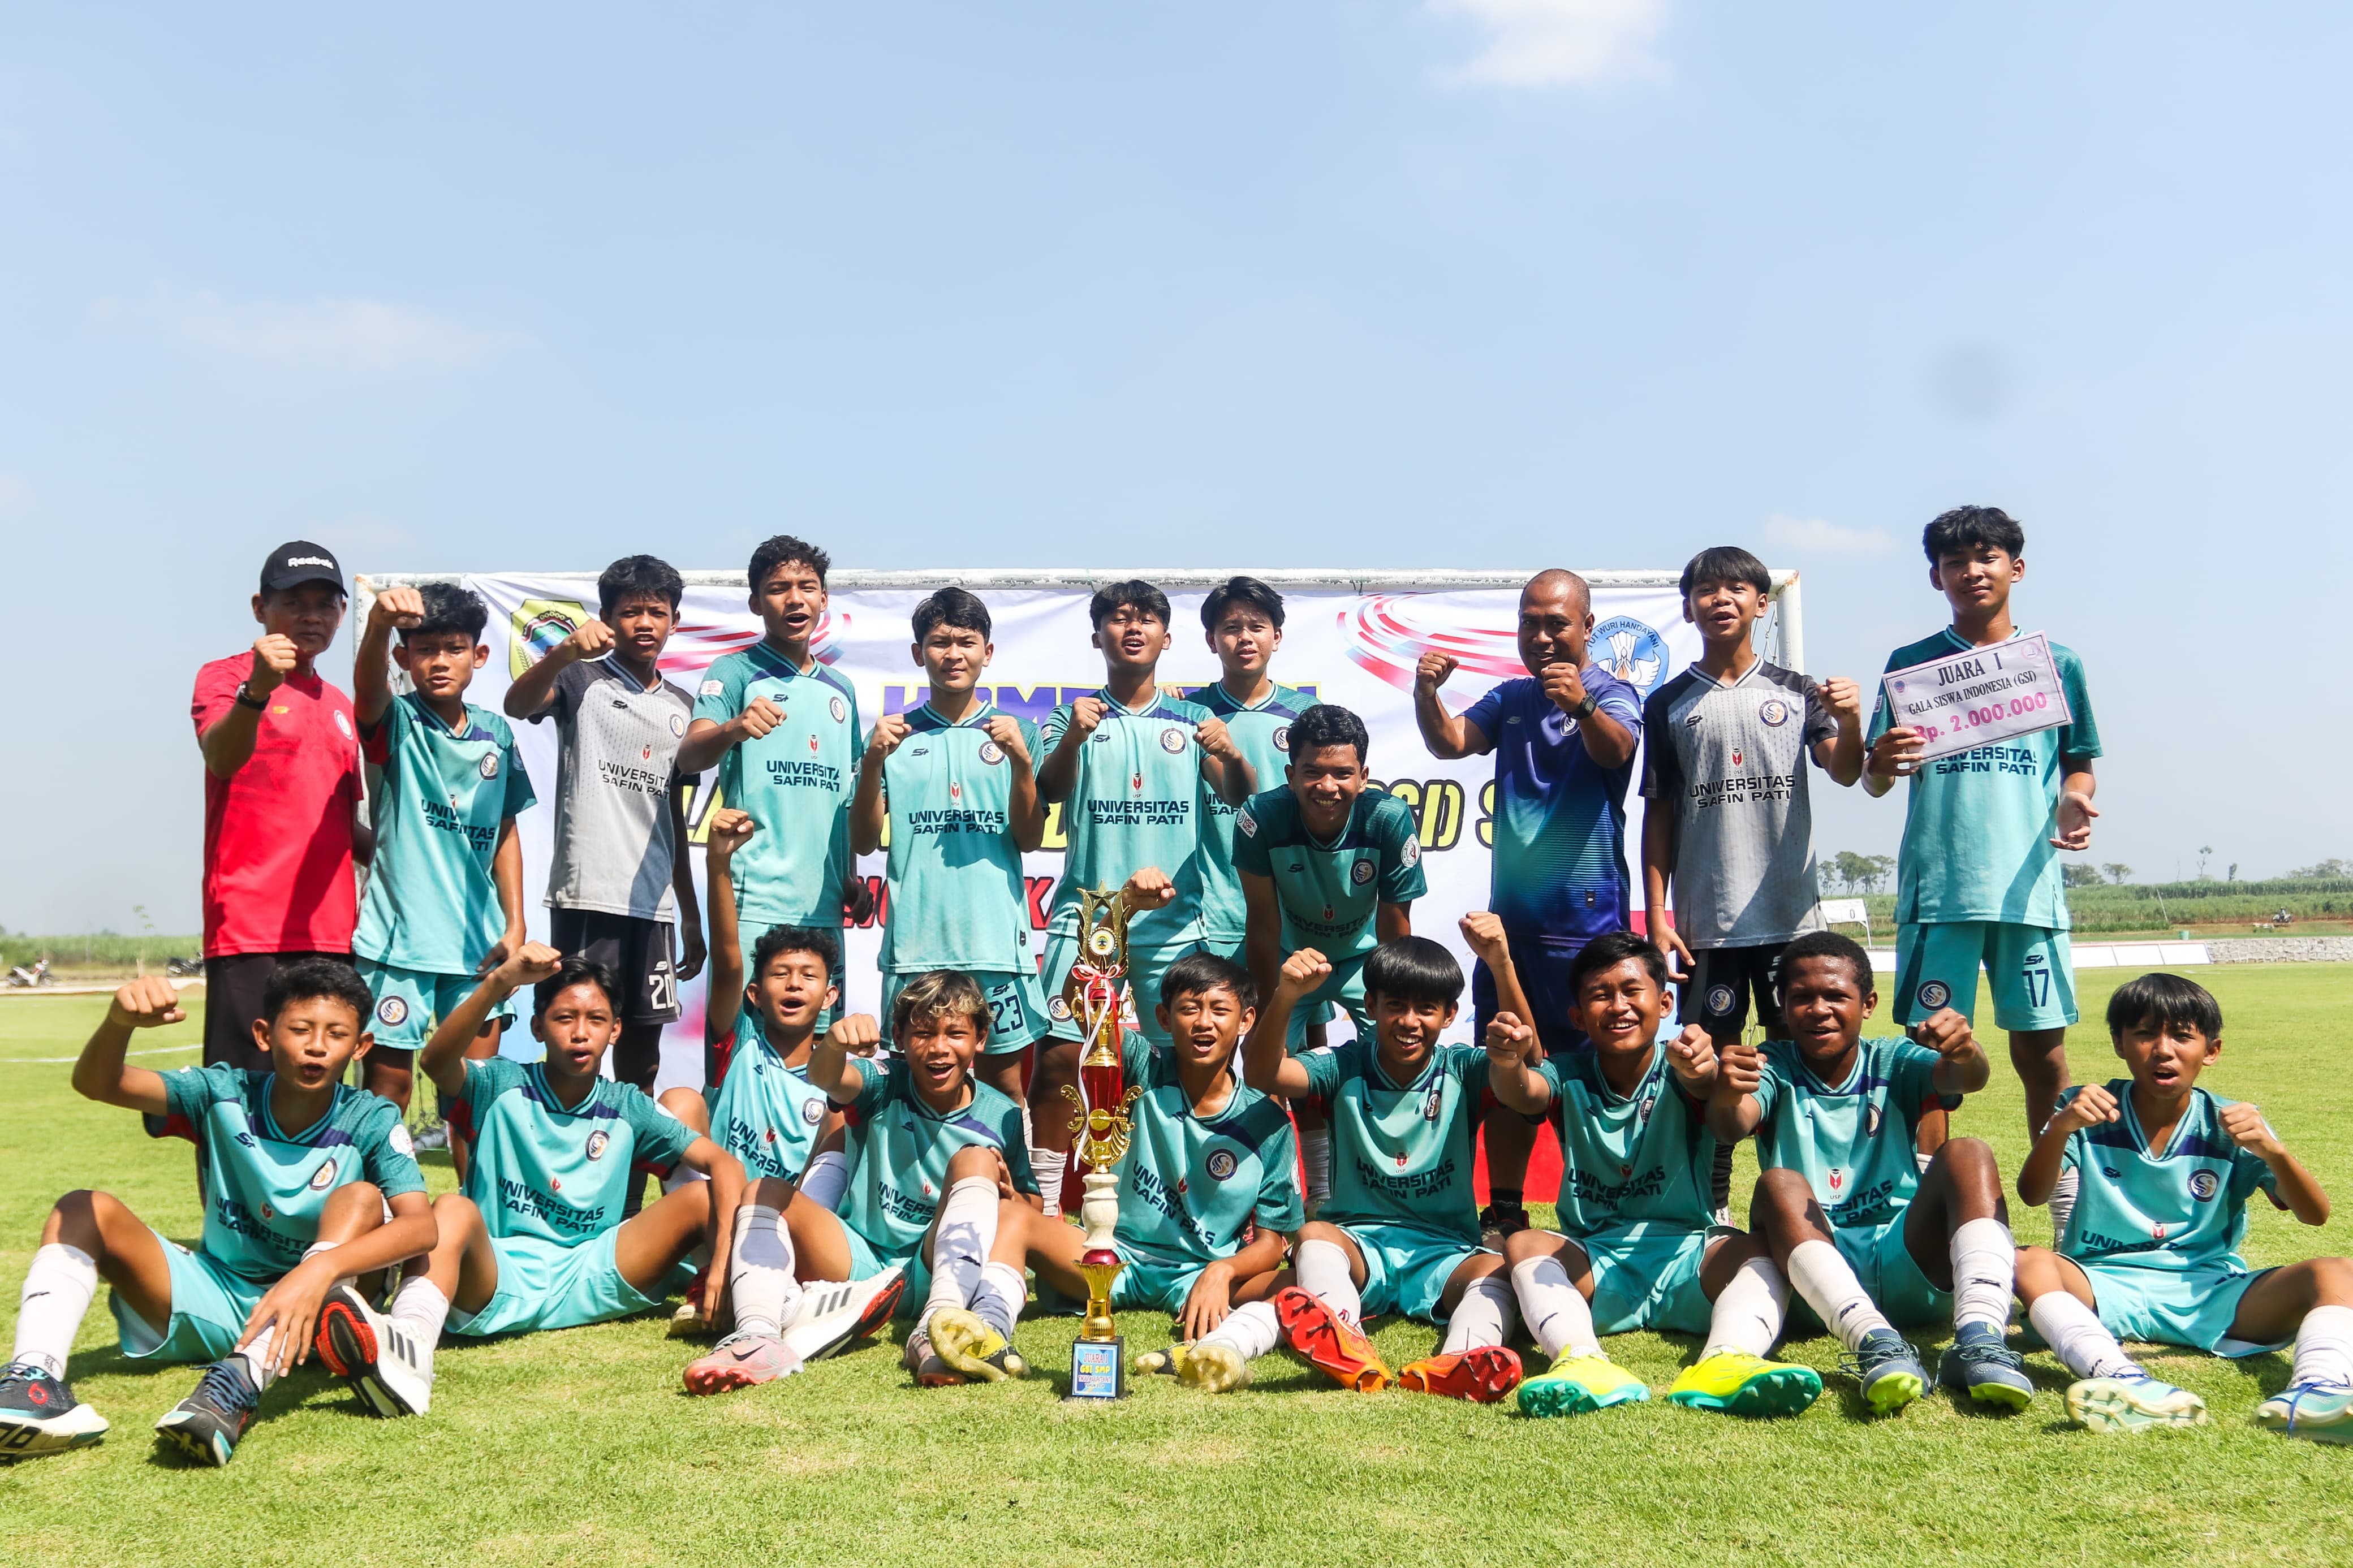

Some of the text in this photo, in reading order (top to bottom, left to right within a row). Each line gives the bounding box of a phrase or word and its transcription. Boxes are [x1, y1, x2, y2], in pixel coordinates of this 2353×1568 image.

[287, 555, 334, 570] Reebok
[1598, 621, 1618, 635] WURI
[1620, 621, 1660, 649] HANDAYANI
[1937, 653, 2003, 686] JUARA I
[1908, 670, 2037, 715] GALA SISWA INDONESIA (GSI)
[1950, 692, 2047, 732] 2.000.000
[598, 759, 670, 789] UNIVERSITA
[766, 760, 840, 780] UNIVERSITA
[1936, 762, 2036, 776] SAFIN PATI
[602, 774, 670, 800] SAFIN PAT
[773, 775, 840, 792] SAFIN PAT
[1690, 775, 1796, 798] UNIVERSITAS
[1087, 800, 1189, 813] UNIVERSITAS
[1697, 790, 1790, 809] SAFIN PATI
[908, 809, 1004, 824] UNIVERSITAS
[1093, 814, 1183, 825] SAFIN PATI
[913, 823, 998, 835] SAFIN PATI
[648, 974, 675, 1010] 20
[2022, 968, 2049, 1008] 17
[988, 994, 1024, 1034] 23
[498, 1174, 605, 1222] UNIVERSITAS
[1416, 1176, 1451, 1198] PATI
[1131, 1178, 1176, 1220] SAFIN
[555, 1217, 596, 1233] PATI
[1083, 1353, 1104, 1363] JUARA
